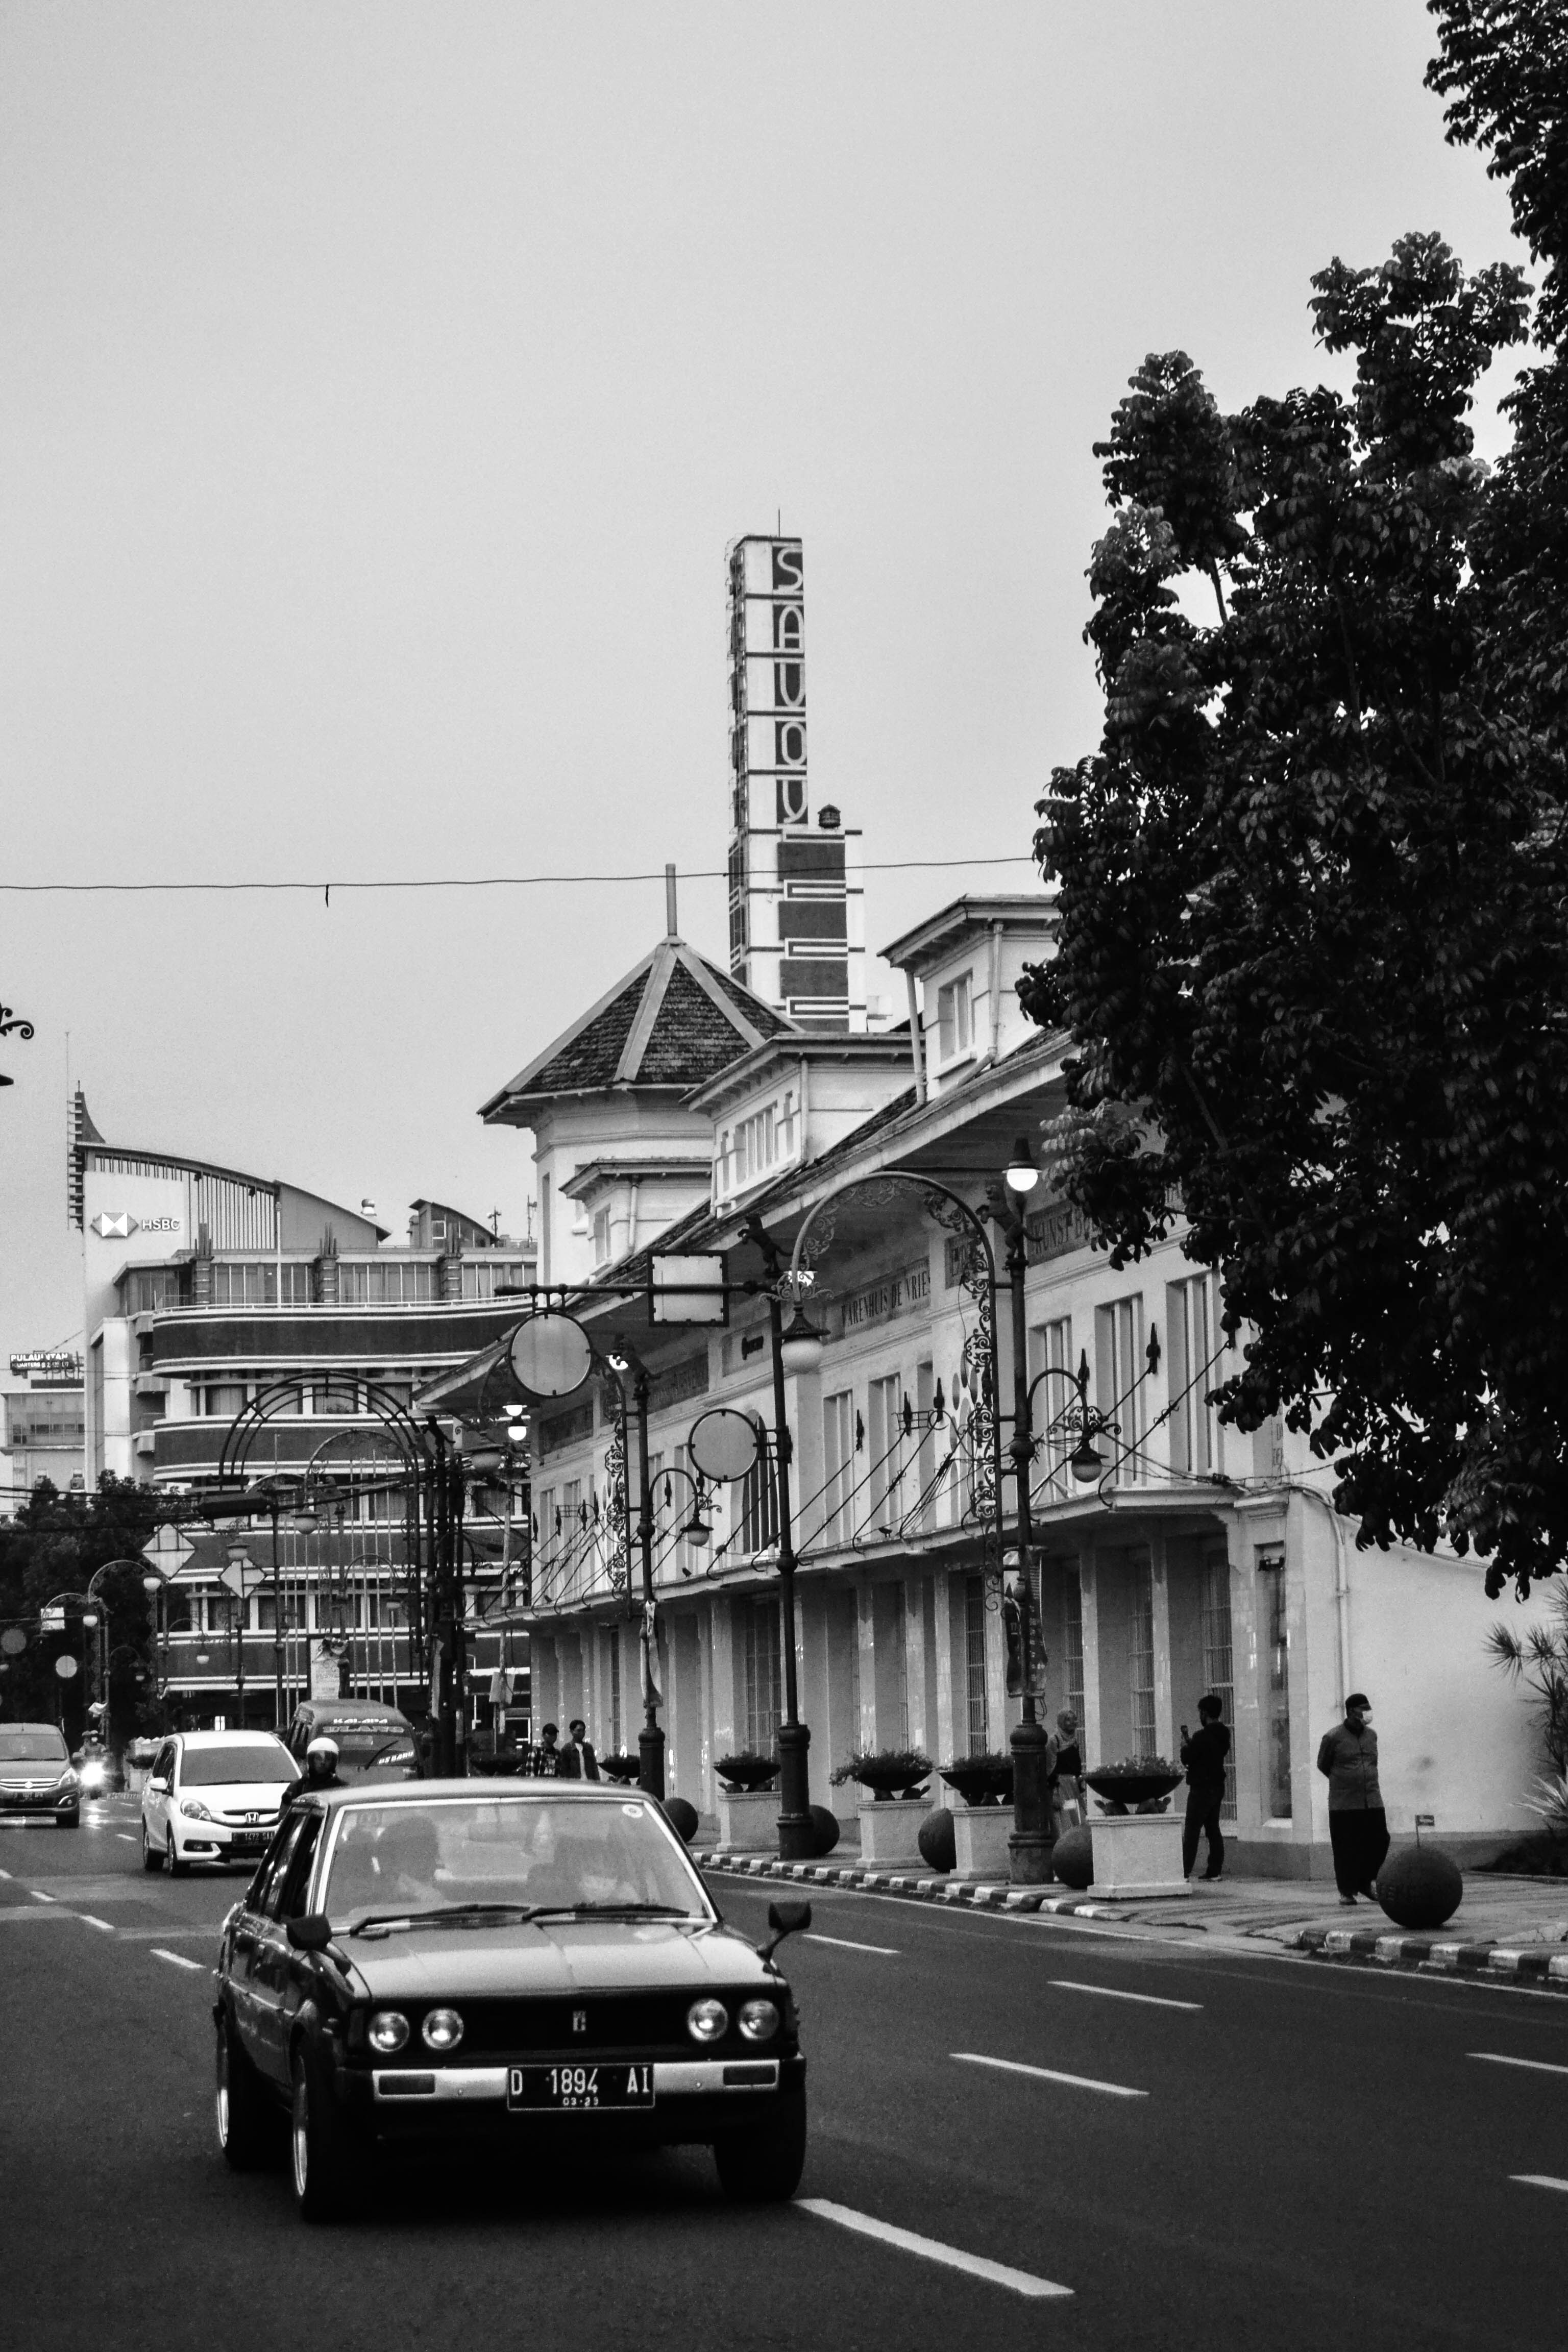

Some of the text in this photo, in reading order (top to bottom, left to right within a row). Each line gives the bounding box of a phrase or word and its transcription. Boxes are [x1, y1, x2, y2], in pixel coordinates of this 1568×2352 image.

[142, 1219, 180, 1231] HSBC
[891, 1280, 902, 1309] DE
[511, 2067, 650, 2095] D 1894 AI
